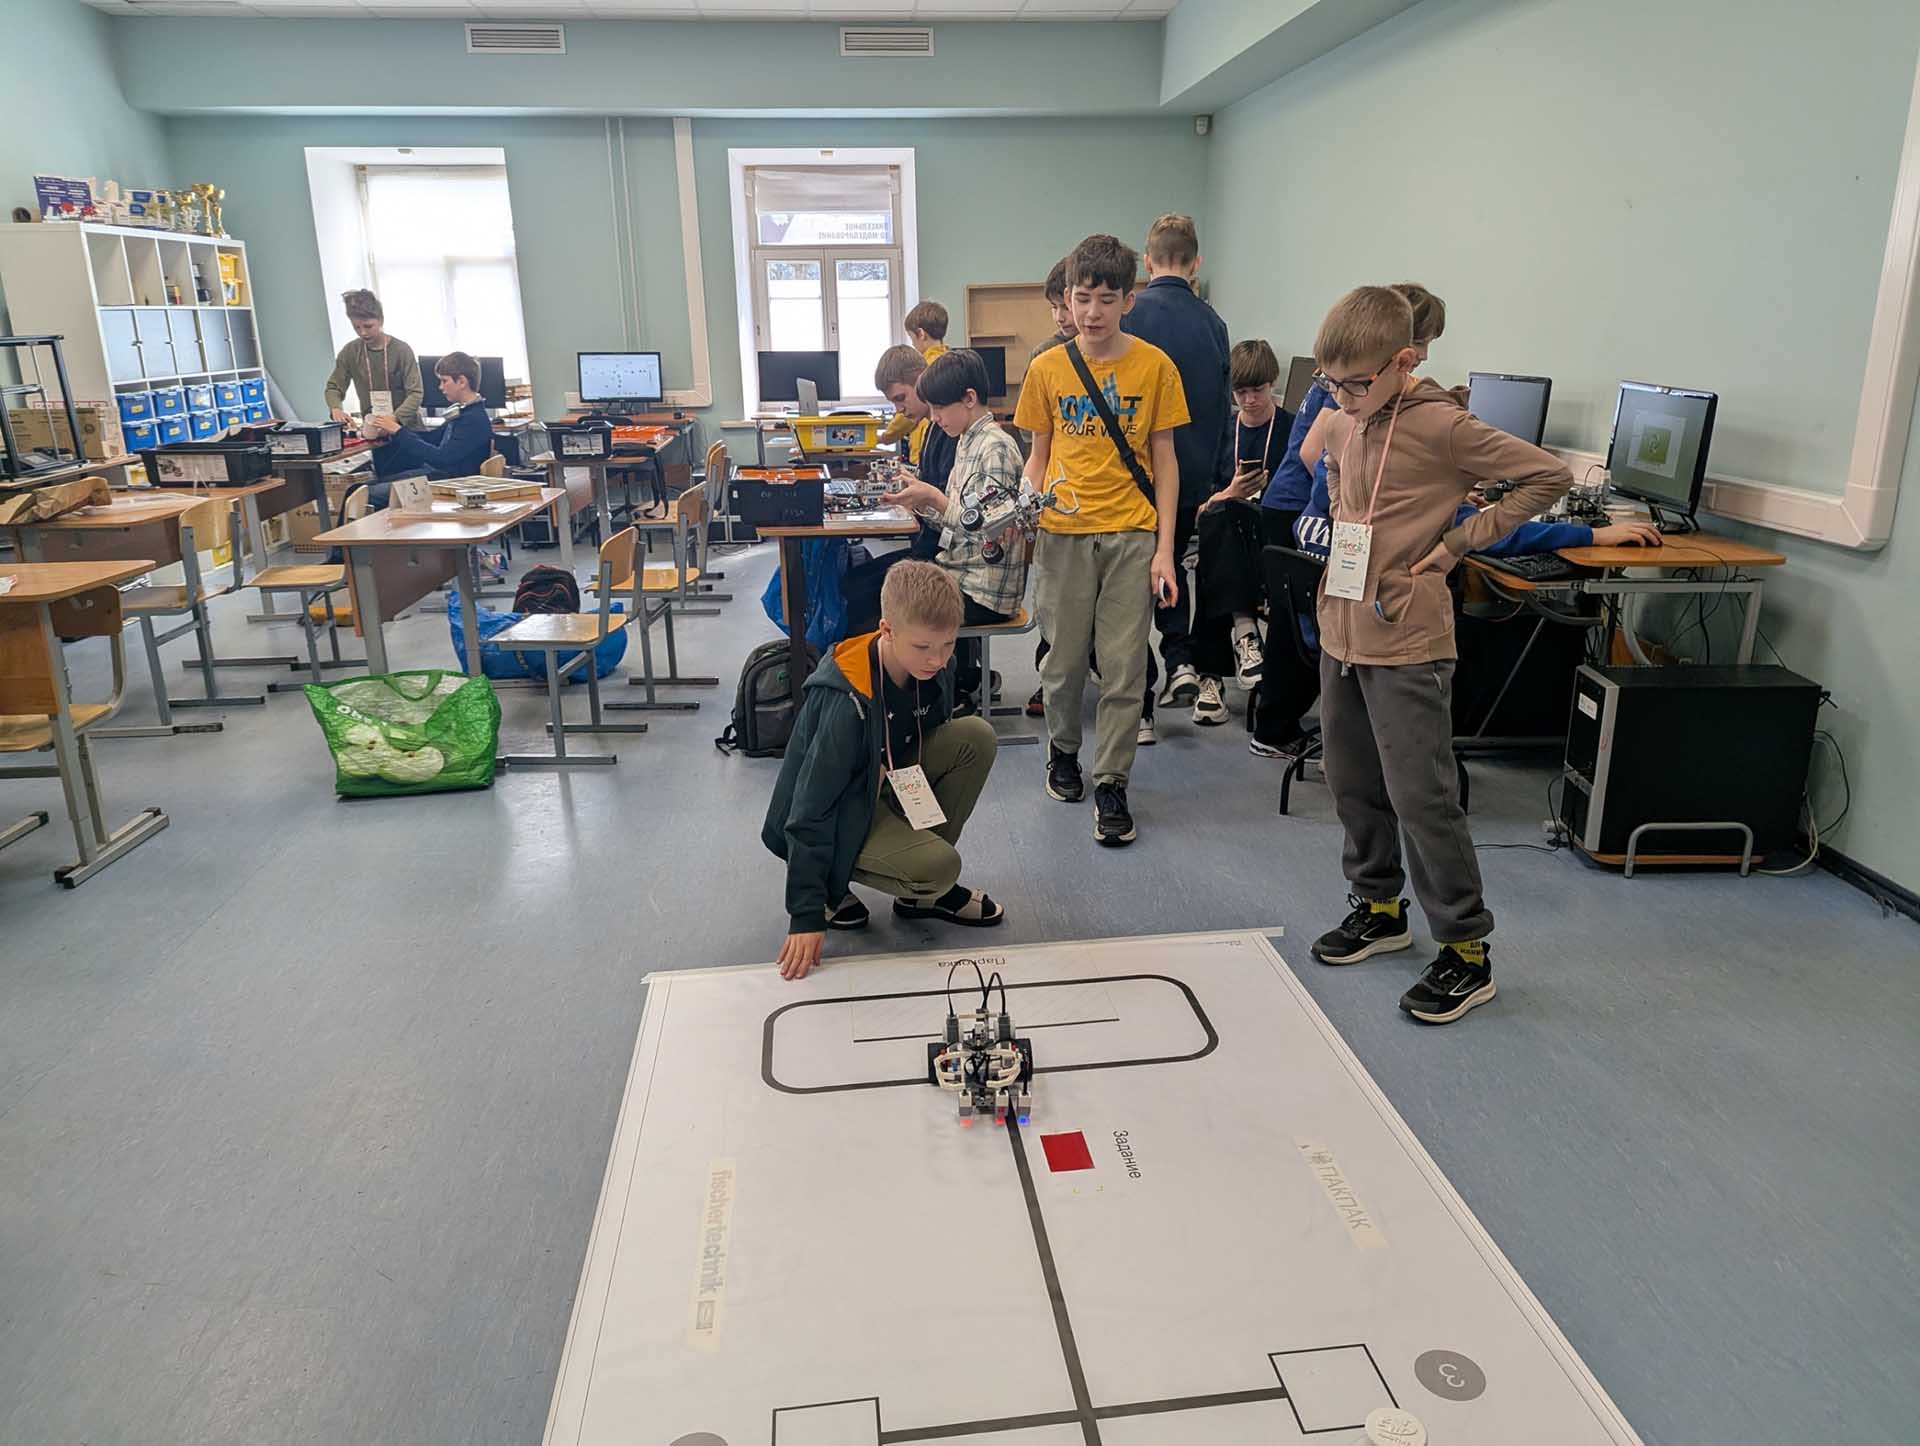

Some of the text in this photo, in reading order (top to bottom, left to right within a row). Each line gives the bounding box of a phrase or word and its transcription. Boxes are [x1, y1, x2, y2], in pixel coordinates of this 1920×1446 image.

[1061, 423, 1137, 437] YOUR WVE
[410, 482, 418, 495] 3
[1112, 1129, 1142, 1179] Задание
[1318, 1166, 1373, 1230] ПАКПАК
[1438, 1362, 1465, 1388] 3
